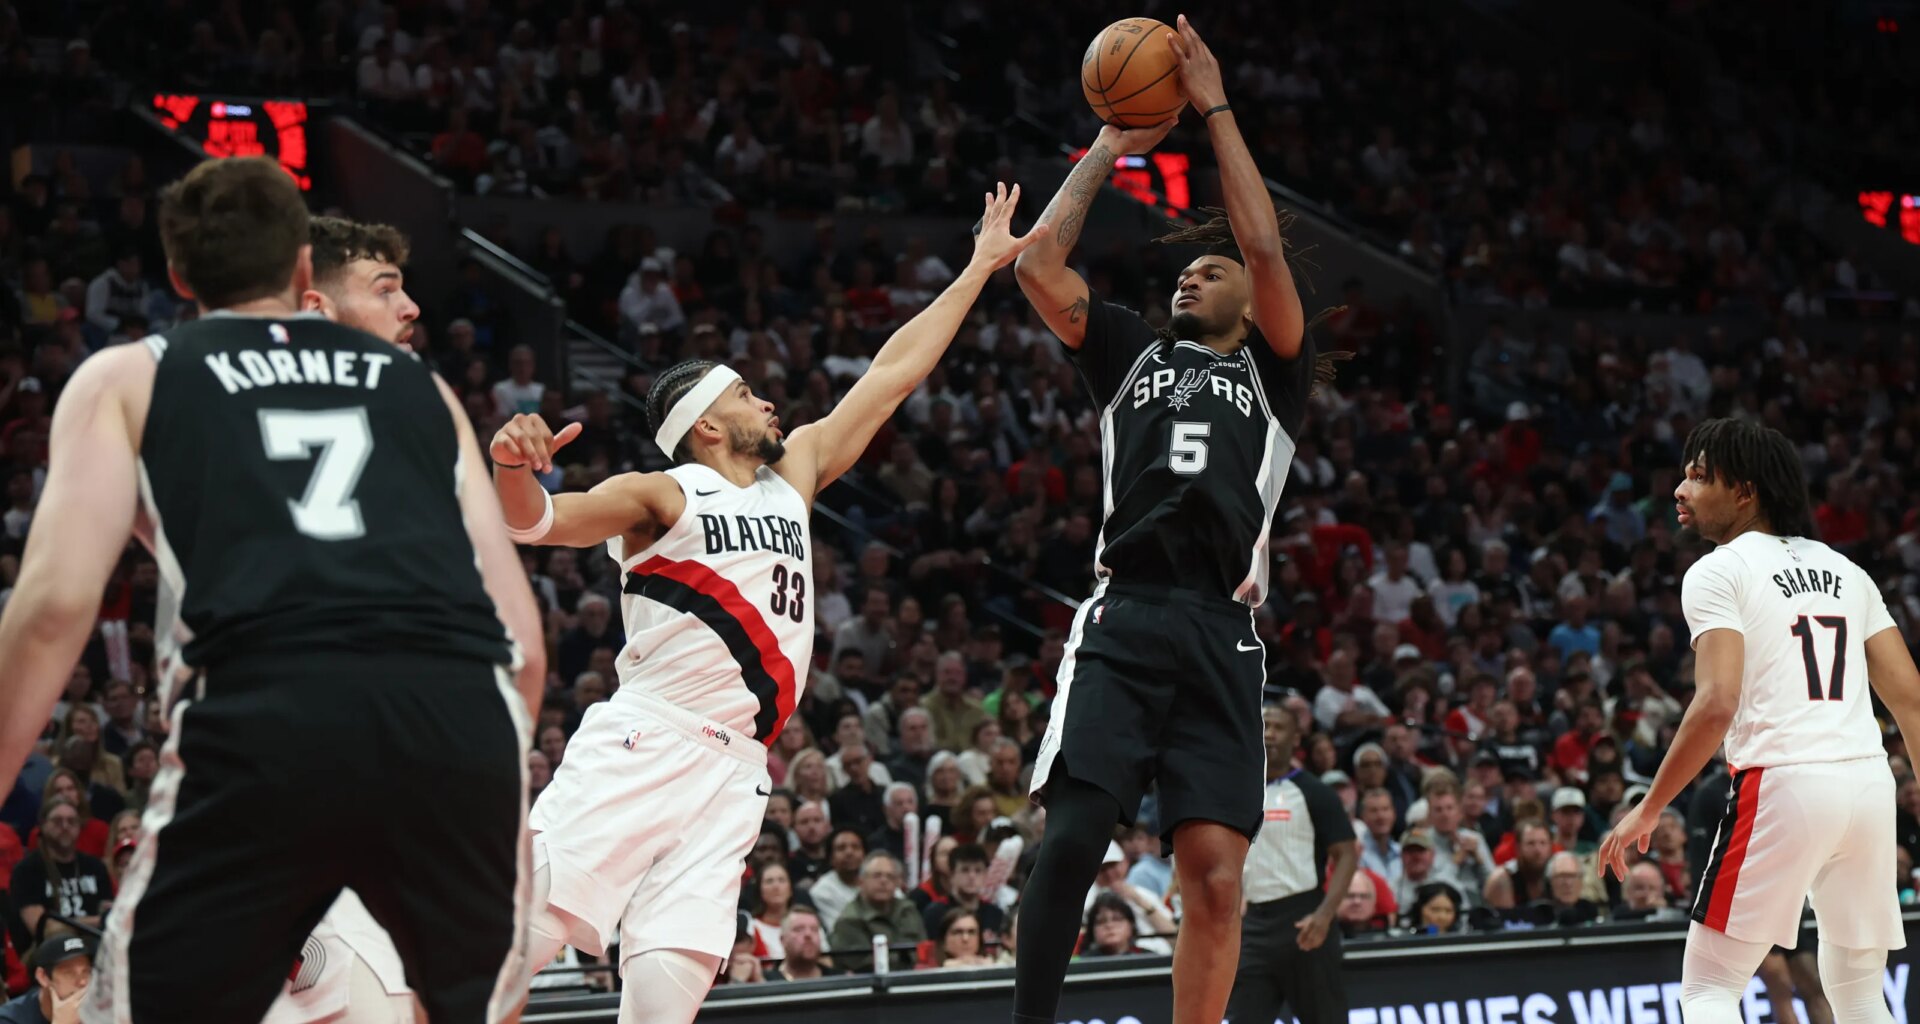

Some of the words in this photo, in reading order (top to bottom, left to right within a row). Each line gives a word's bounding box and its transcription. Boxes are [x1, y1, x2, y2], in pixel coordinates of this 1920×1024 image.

[205, 349, 392, 394] KORNET
[257, 406, 374, 541] 7
[1168, 421, 1210, 474] 5
[697, 514, 804, 561] BLAZERS
[770, 563, 805, 624] 33
[1773, 567, 1843, 599] SHARPE
[1790, 614, 1847, 701] 17
